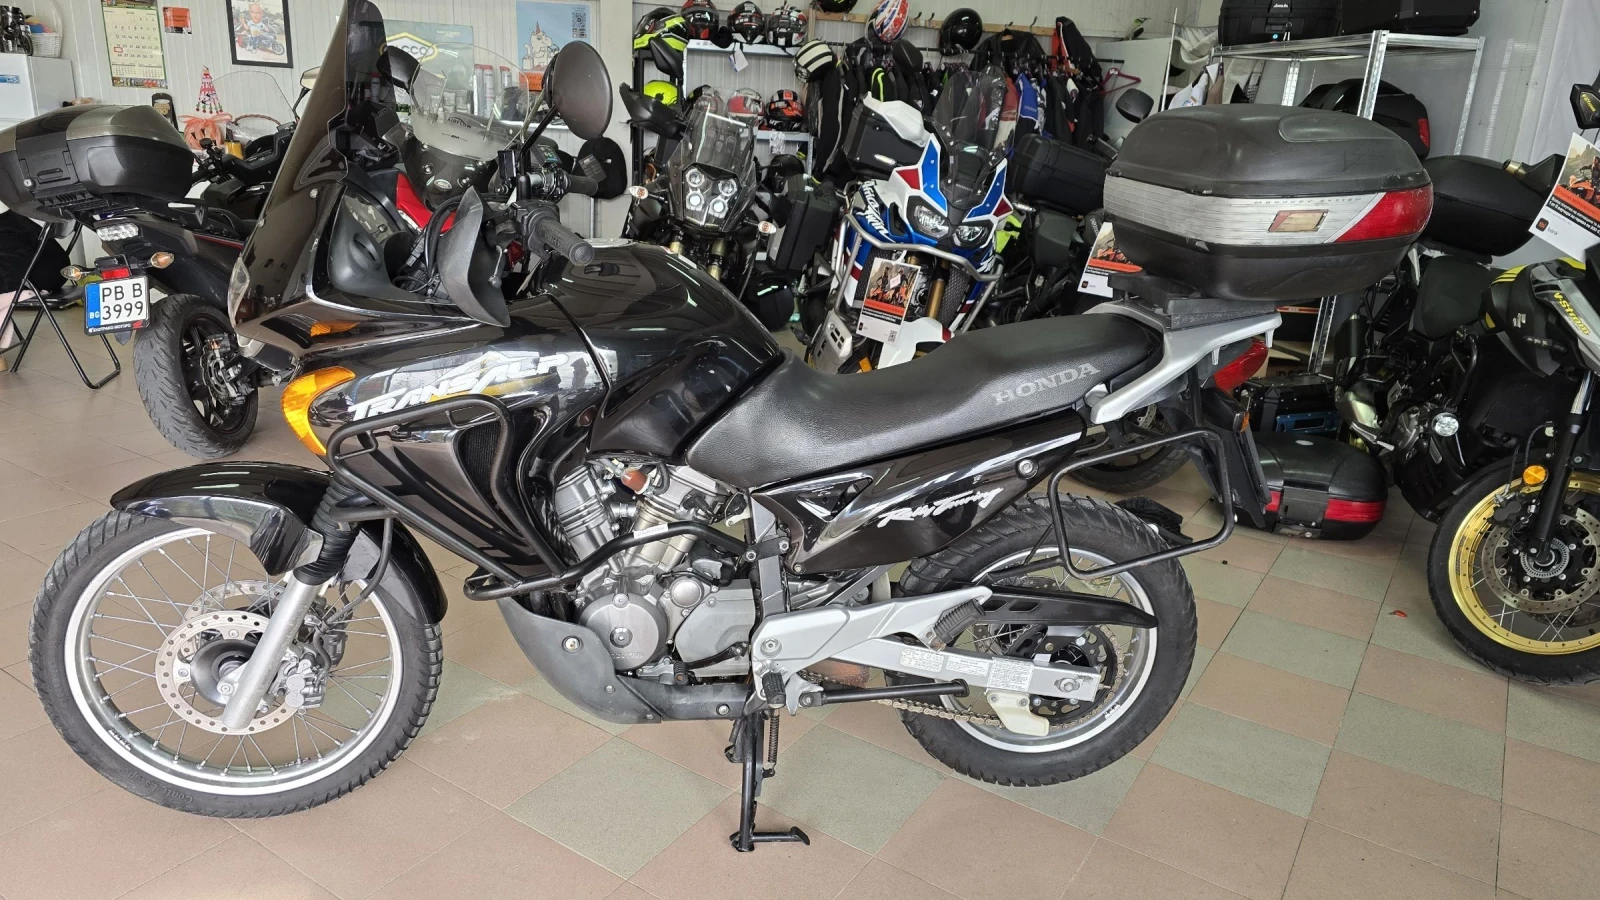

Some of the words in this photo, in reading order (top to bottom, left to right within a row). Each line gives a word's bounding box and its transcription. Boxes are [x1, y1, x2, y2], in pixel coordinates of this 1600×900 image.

[102, 286, 124, 302] PB
[132, 283, 142, 298] B
[90, 311, 100, 320] BG
[102, 301, 144, 320] 3999
[347, 351, 569, 422] TRANSALP
[992, 363, 1100, 405] HONDA
